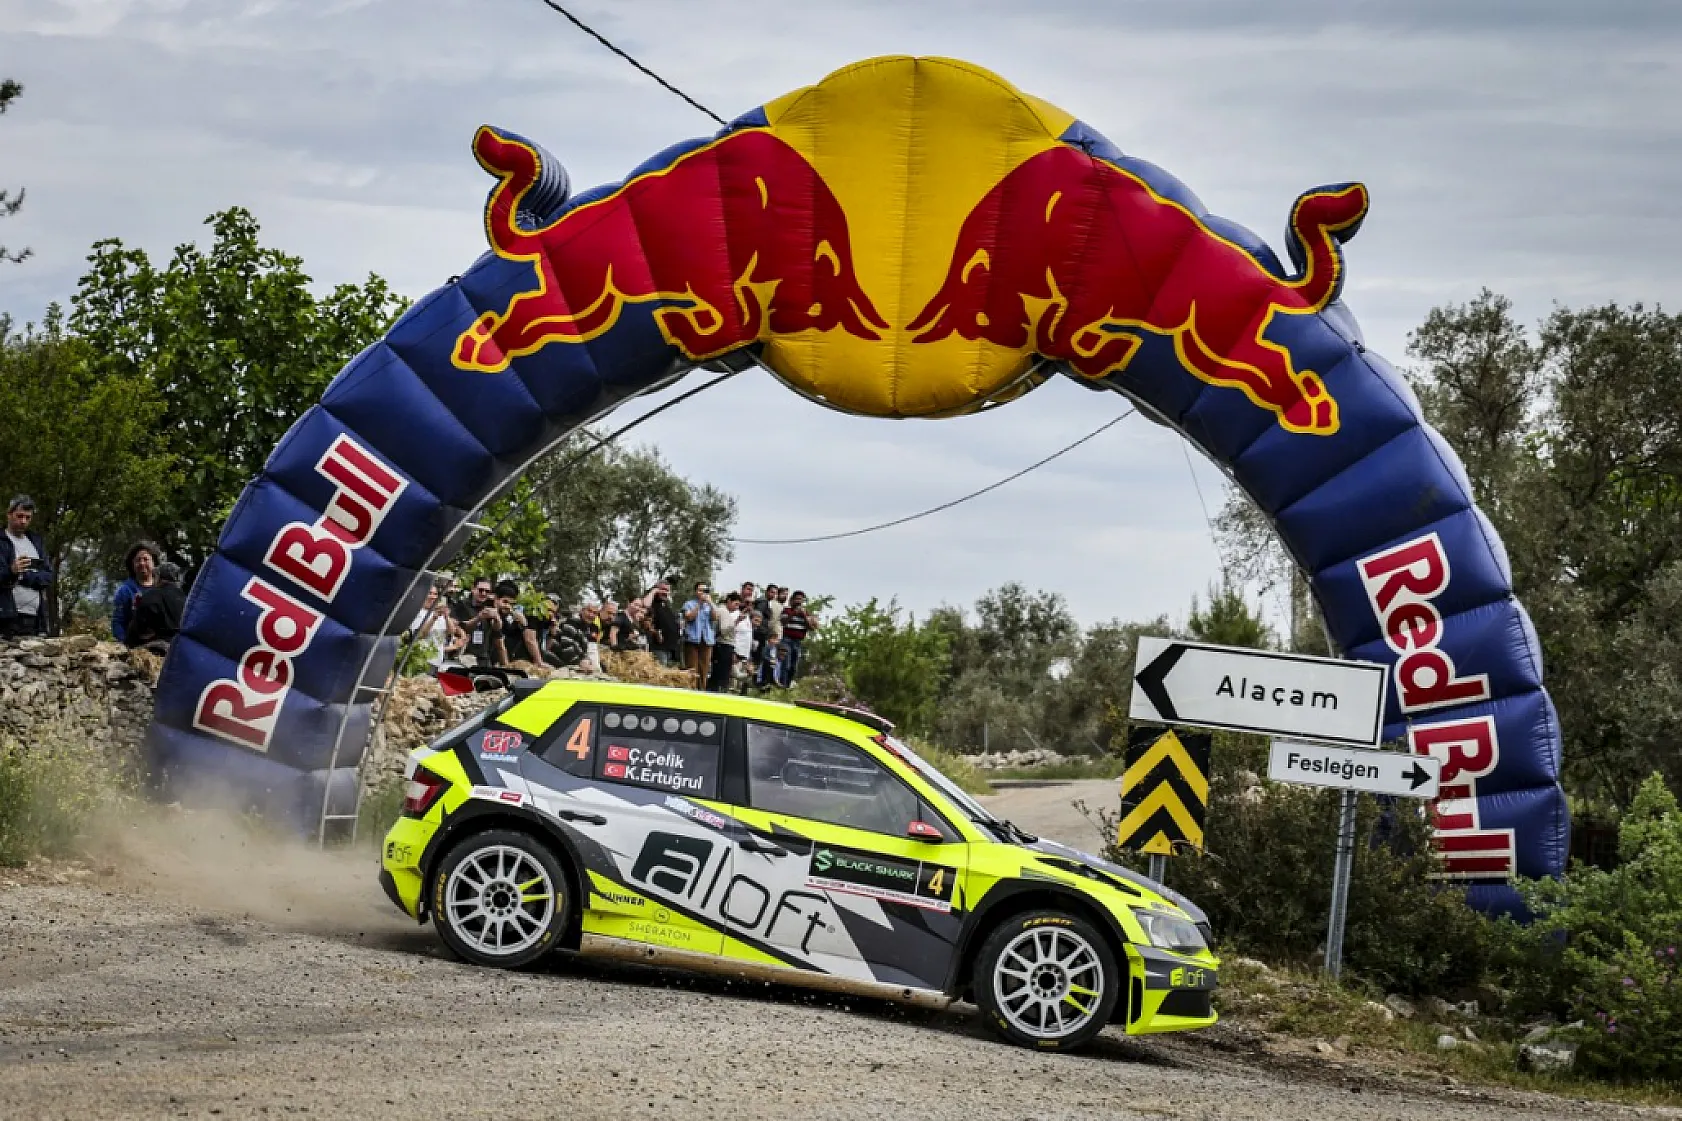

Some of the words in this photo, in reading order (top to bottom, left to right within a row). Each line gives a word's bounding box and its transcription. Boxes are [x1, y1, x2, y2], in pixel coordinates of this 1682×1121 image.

[193, 576, 325, 752] Red
[263, 433, 409, 604] Bull
[1356, 532, 1490, 714] Red
[1215, 675, 1339, 710] Alaçam
[565, 718, 591, 760] 4
[629, 747, 684, 769] Ç.Çelik
[1287, 752, 1379, 780] Fesleğen
[624, 765, 704, 790] K.Ertuğrul
[836, 857, 872, 873] BLACK
[875, 864, 914, 880] SHARK
[927, 868, 945, 896] 4
